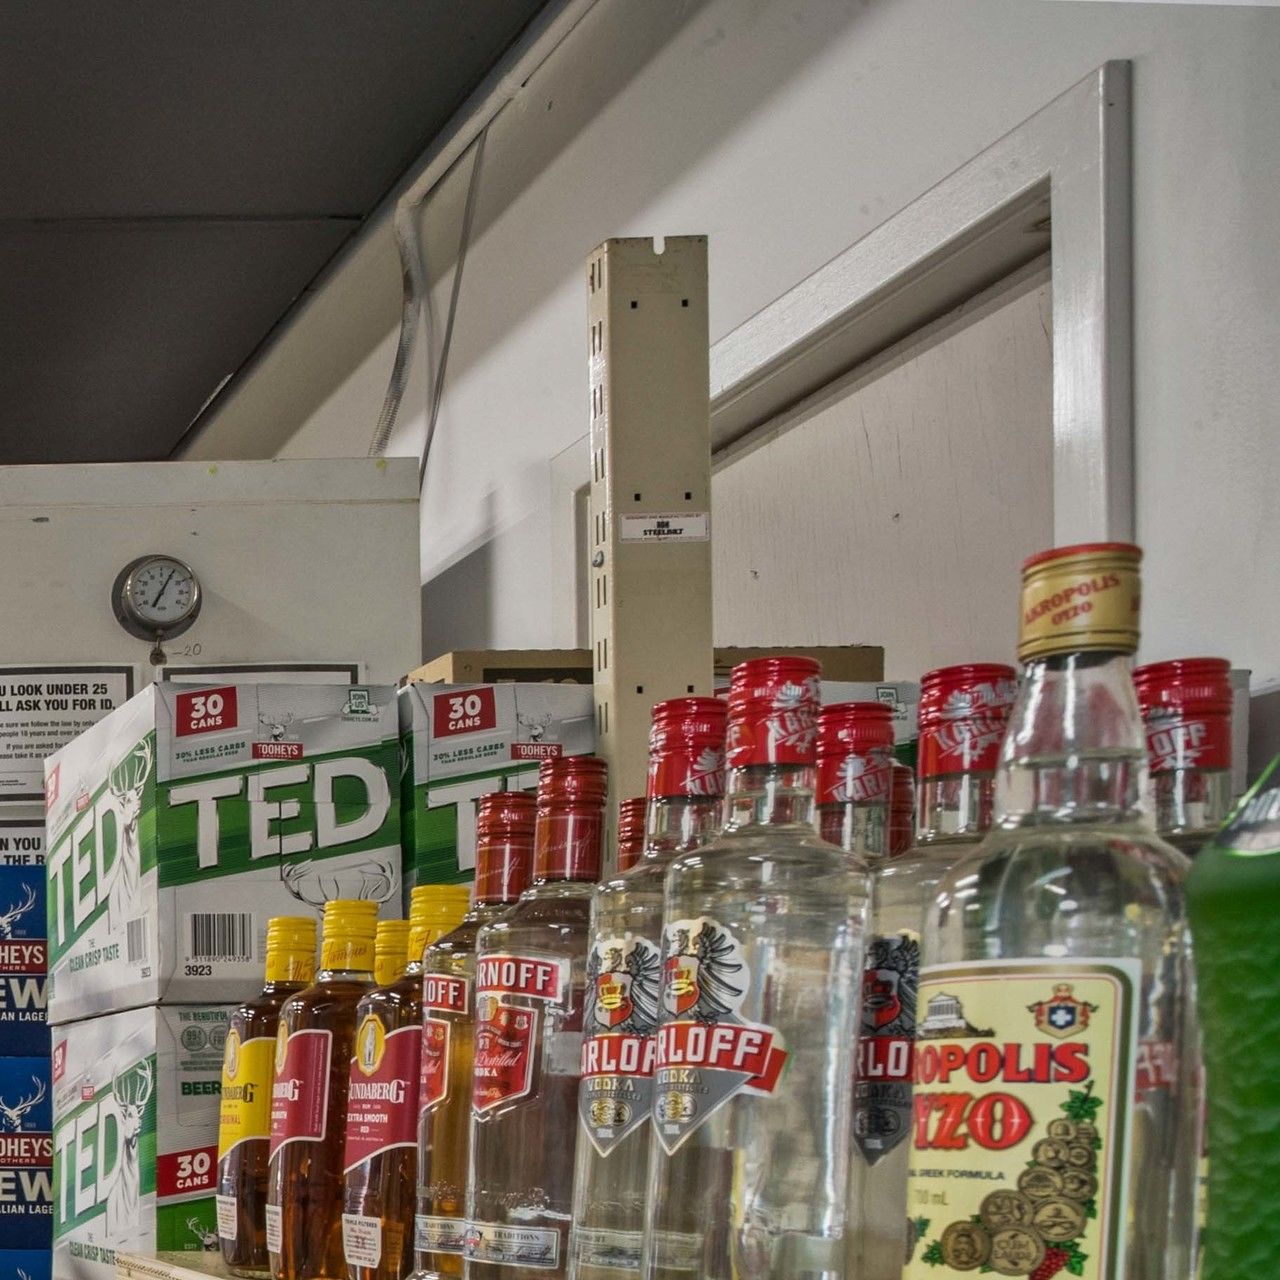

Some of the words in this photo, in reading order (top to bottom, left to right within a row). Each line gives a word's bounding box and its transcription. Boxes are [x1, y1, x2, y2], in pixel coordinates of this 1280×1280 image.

[10, 685, 42, 696] LOOK
[47, 684, 89, 695] UNDER
[93, 684, 108, 694] 25
[16, 701, 41, 711] ASK
[44, 700, 69, 710] YOU
[73, 700, 96, 710] FOR
[191, 694, 224, 718] 30
[191, 717, 222, 729] CANS
[195, 747, 215, 756] LESS
[218, 742, 246, 751] CARBS
[258, 744, 298, 755] TOOHEYS
[170, 756, 392, 868] TED
[185, 965, 212, 976] 3923
[181, 1081, 221, 1095] BEER
[590, 1080, 634, 1091] VODKA
[363, 1114, 388, 1123] SMOOTH
[946, 1170, 1005, 1180] FORMULA
